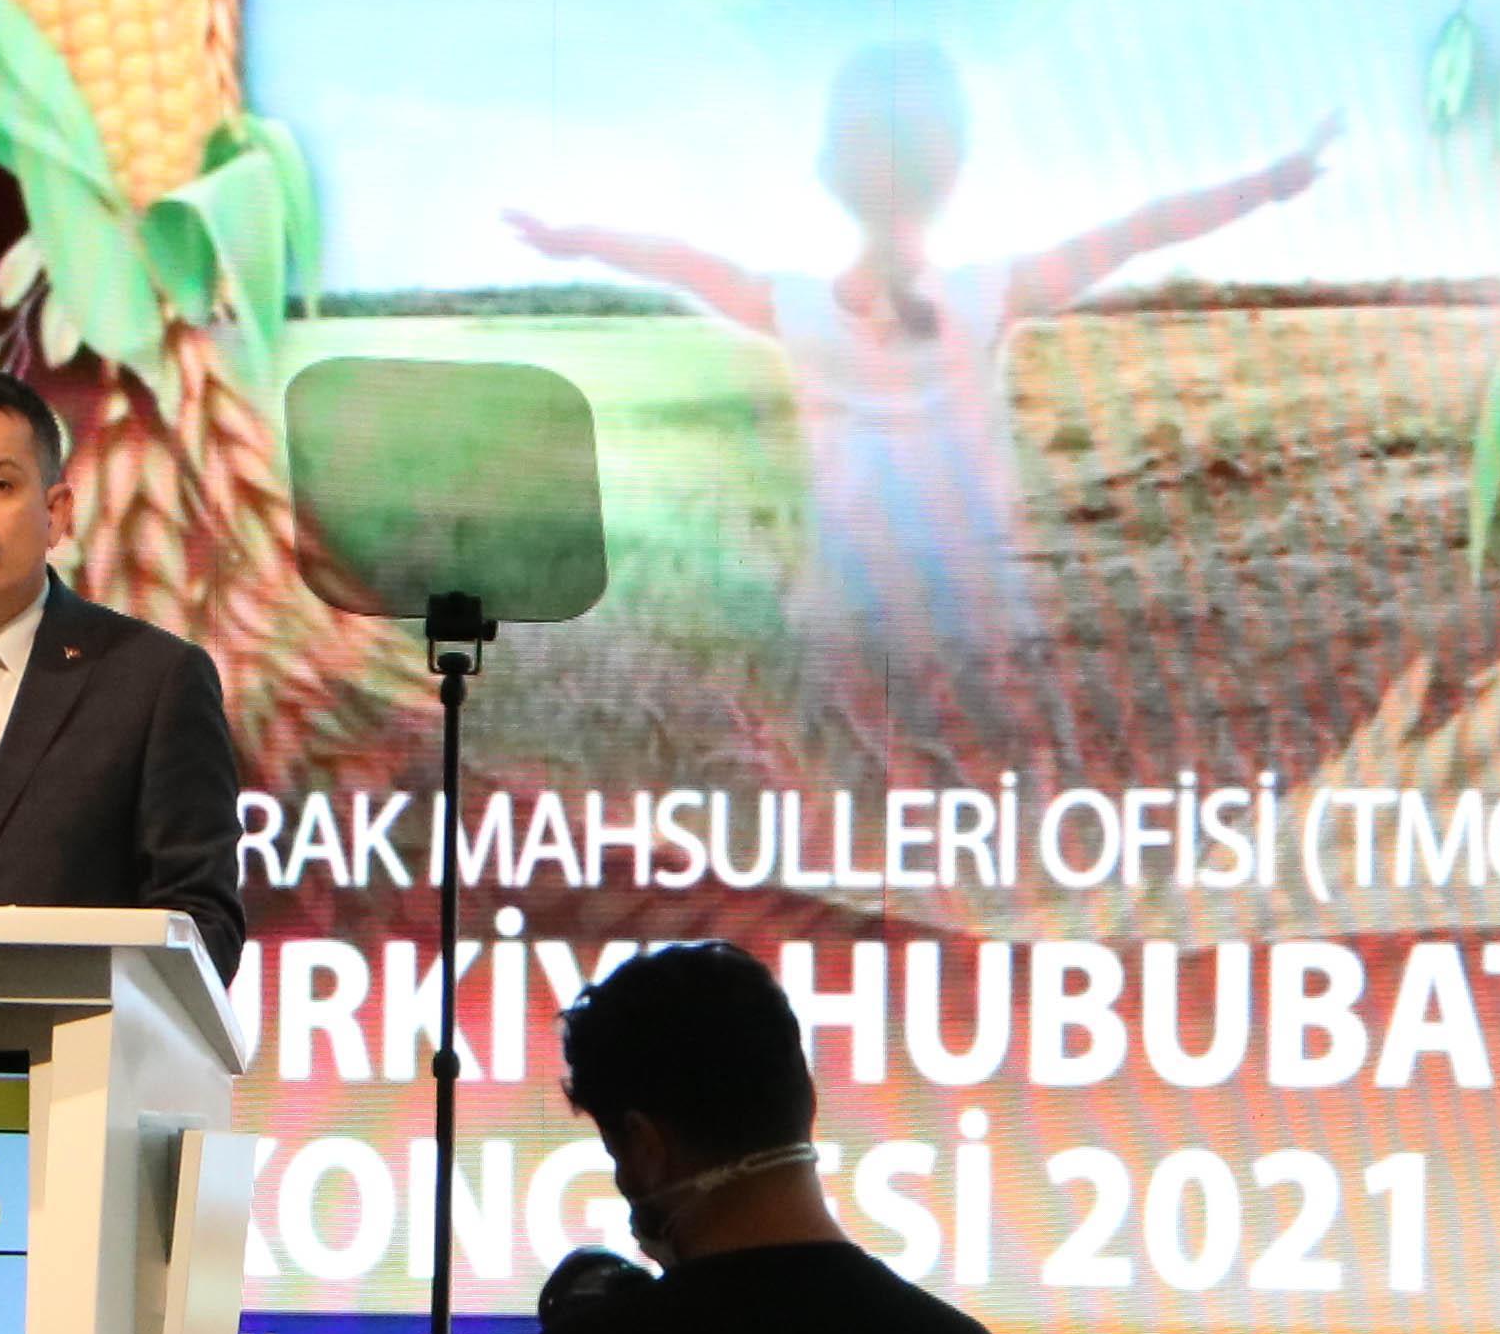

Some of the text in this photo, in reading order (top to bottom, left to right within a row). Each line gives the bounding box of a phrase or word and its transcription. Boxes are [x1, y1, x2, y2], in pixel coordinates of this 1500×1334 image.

[428, 770, 1019, 889] MAHSULLERİ
[1039, 769, 1278, 890] OFİSİ
[1041, 1146, 1428, 1293] 2021
